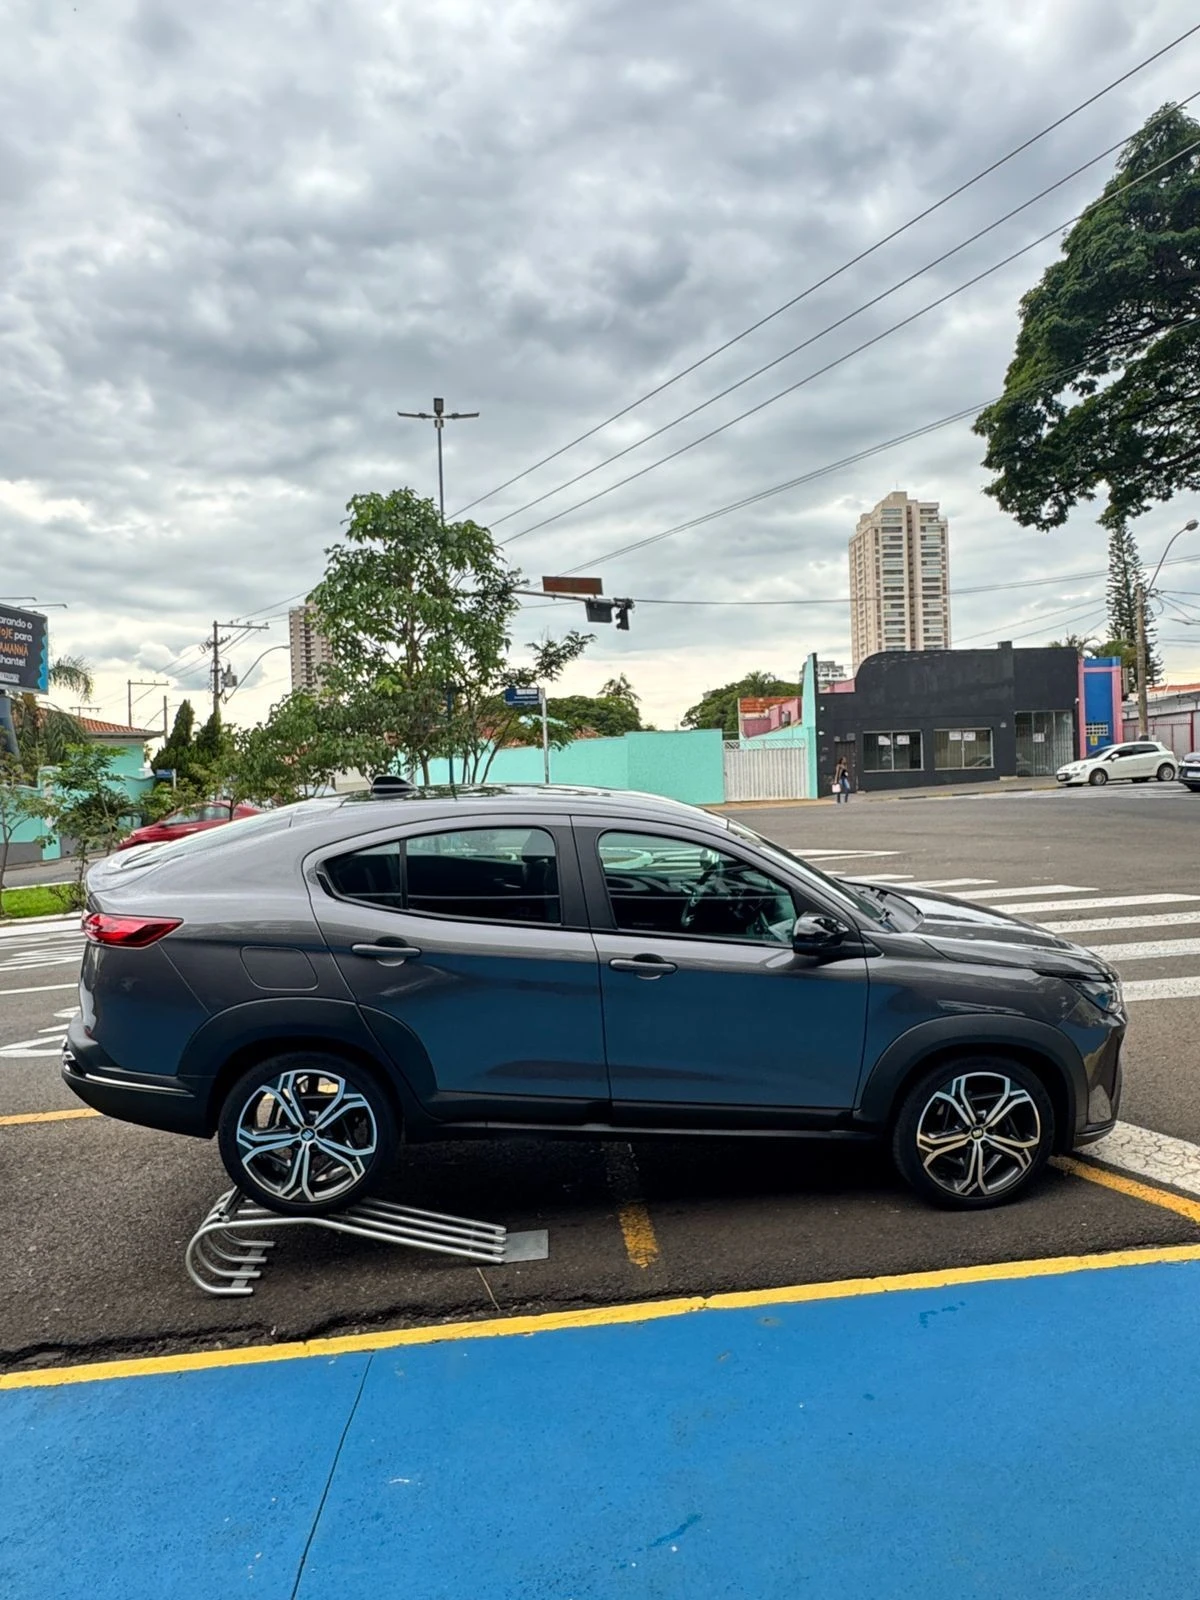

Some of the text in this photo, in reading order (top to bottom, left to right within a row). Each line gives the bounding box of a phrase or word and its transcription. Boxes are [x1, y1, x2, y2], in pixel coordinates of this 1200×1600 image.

[27, 622, 33, 630] o
[0, 627, 33, 642] OJE para
